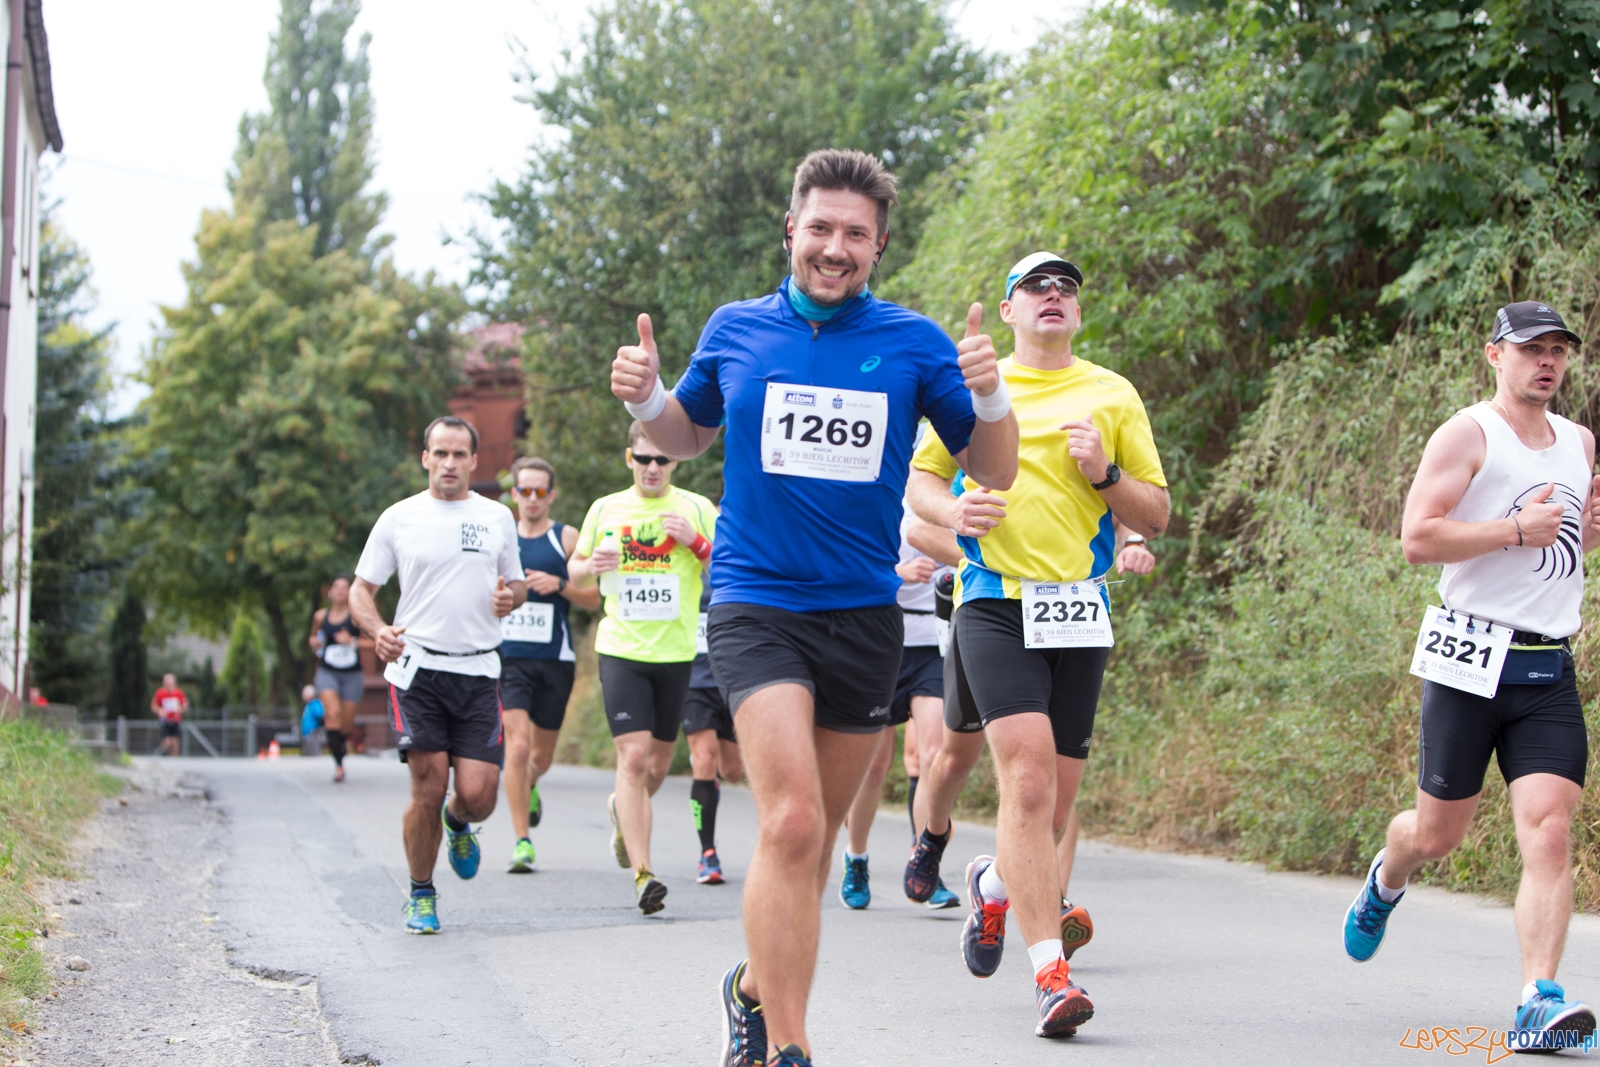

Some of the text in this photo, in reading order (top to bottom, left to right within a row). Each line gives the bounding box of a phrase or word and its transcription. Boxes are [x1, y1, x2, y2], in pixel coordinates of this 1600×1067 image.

[778, 412, 873, 448] 1269
[788, 450, 801, 459] 39
[802, 452, 824, 462] BIEG
[461, 530, 478, 539] NA
[461, 538, 483, 547] RYJ
[625, 589, 672, 603] 1495
[1033, 601, 1099, 622] 2327
[508, 614, 545, 627] 2336
[1425, 630, 1492, 669] 2521
[1430, 661, 1438, 669] 39
[1438, 663, 1455, 674] BIEG
